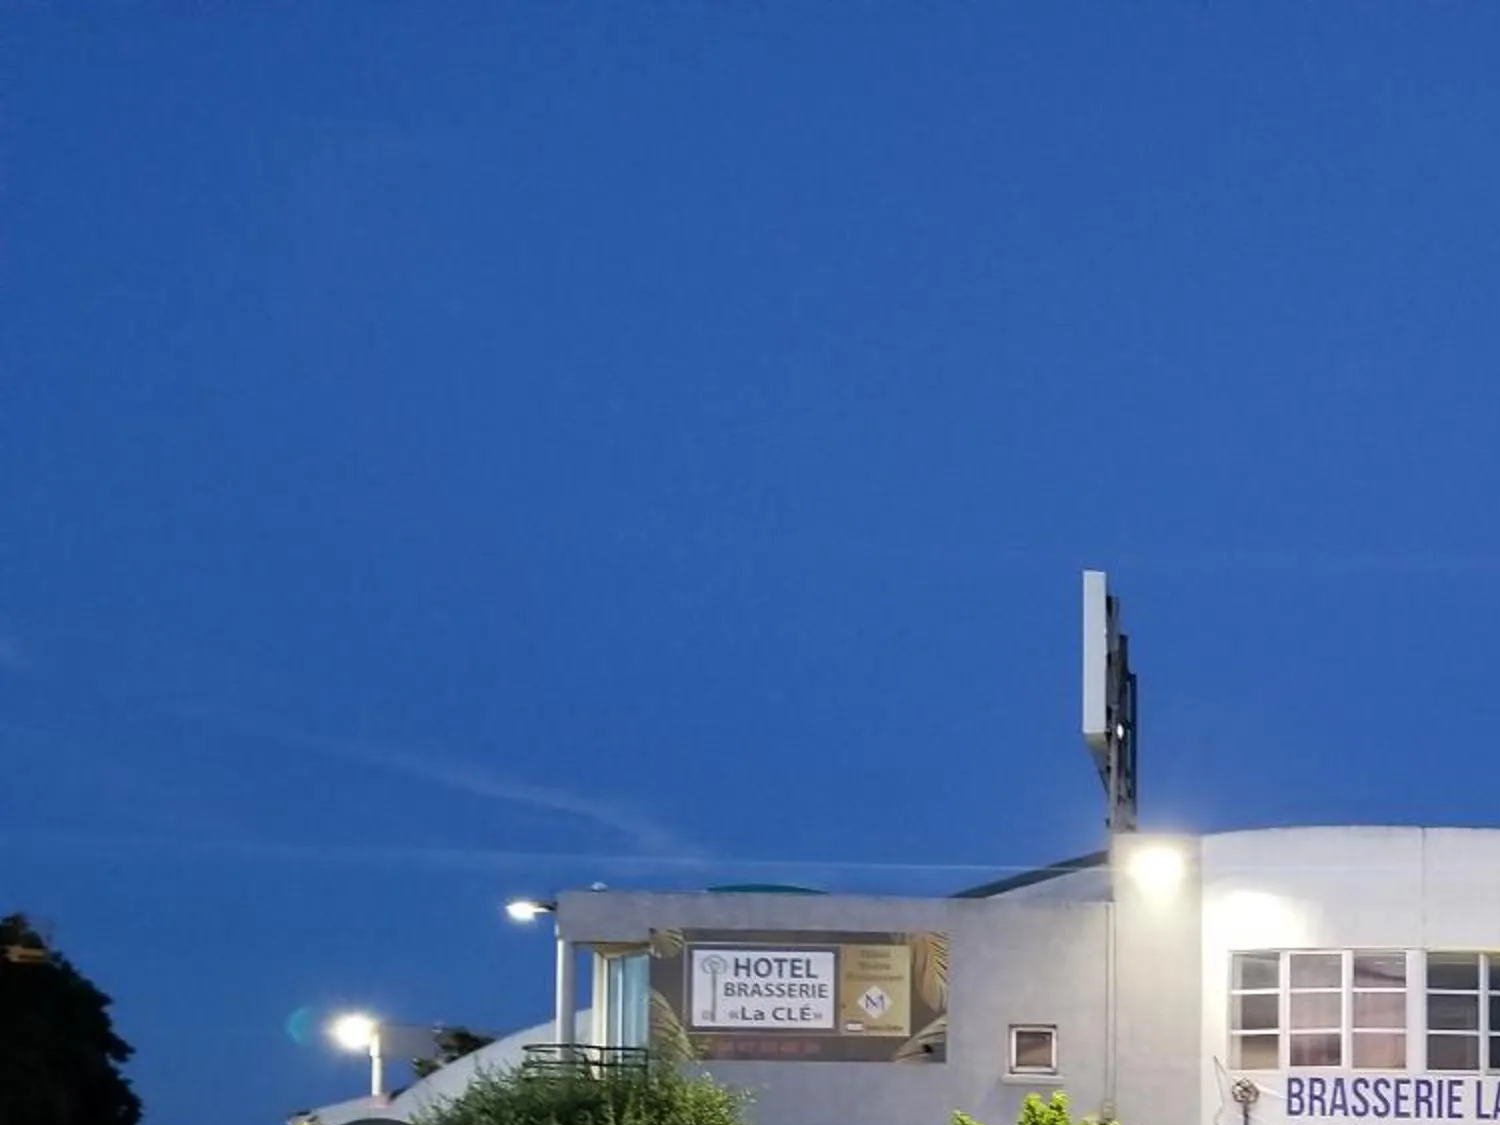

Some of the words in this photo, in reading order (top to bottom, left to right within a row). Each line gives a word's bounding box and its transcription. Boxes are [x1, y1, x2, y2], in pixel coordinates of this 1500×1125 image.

[734, 957, 818, 979] HOTEL
[723, 982, 829, 999] BRASSERIE
[1287, 1077, 1464, 1119] BRASSERIE
